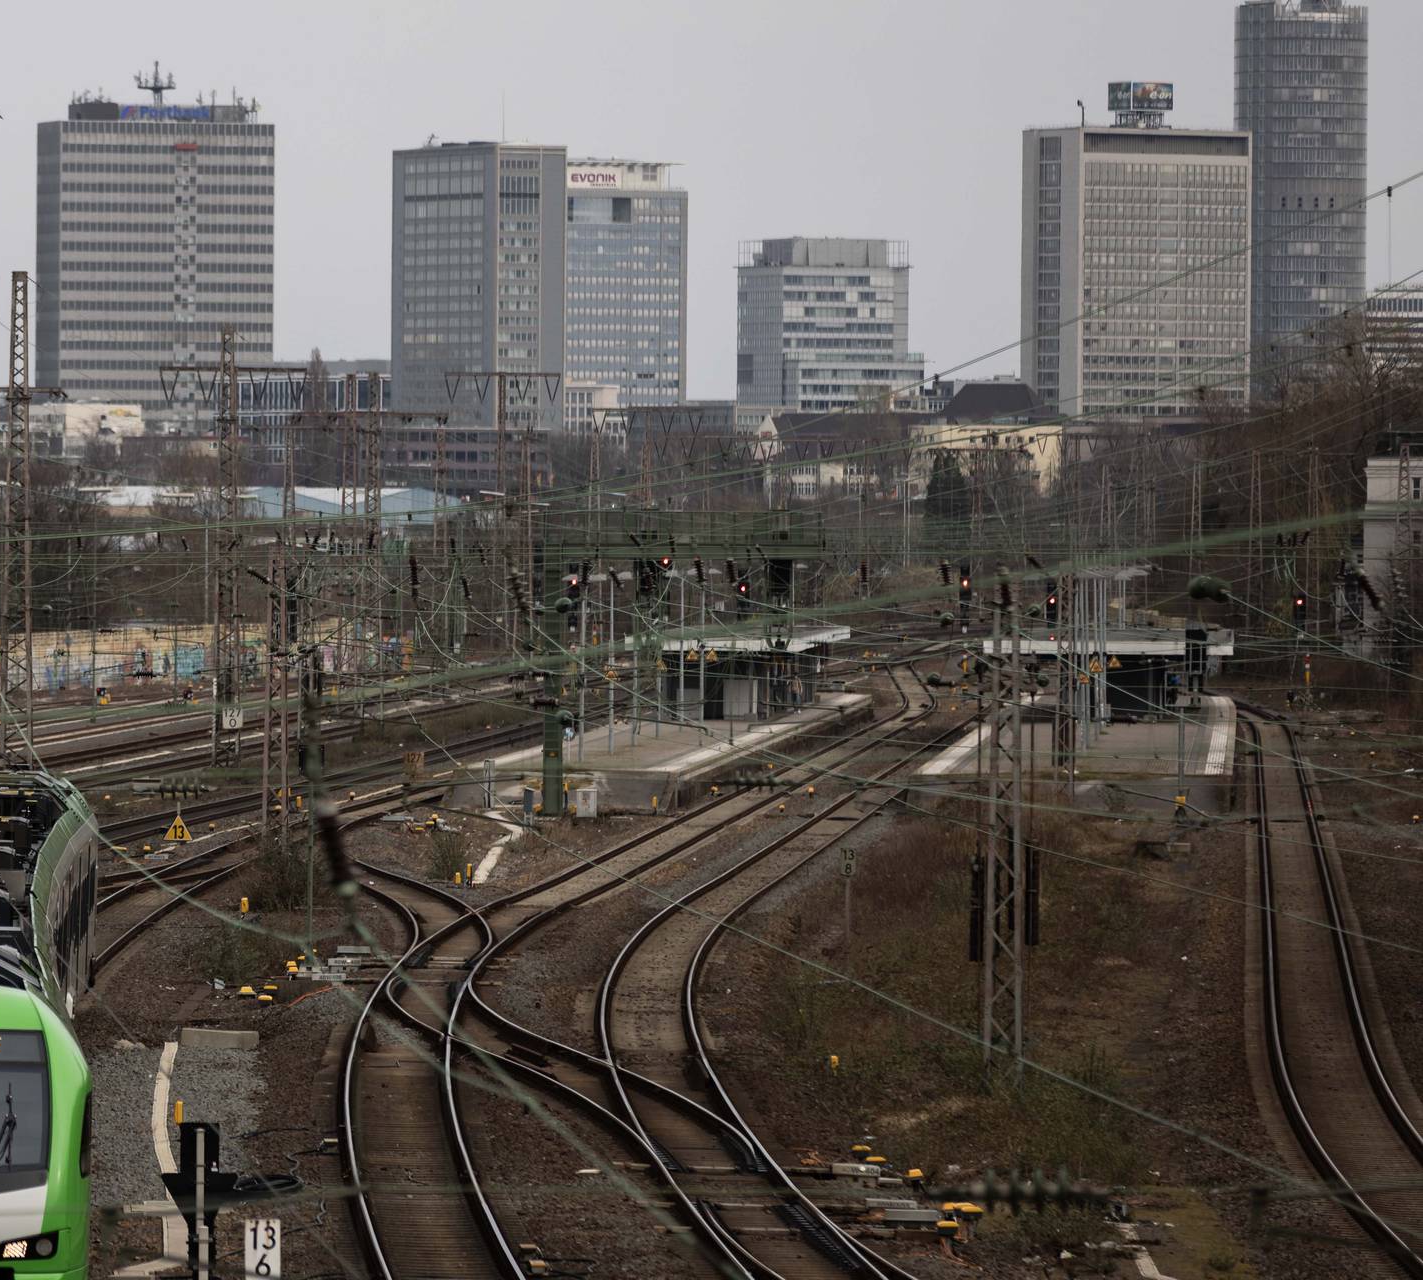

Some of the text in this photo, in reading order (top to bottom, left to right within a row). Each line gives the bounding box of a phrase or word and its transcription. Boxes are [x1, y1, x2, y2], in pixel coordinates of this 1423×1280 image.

[571, 173, 617, 183] EVONIK
[224, 707, 241, 718] 127
[172, 825, 185, 839] 13
[842, 849, 855, 861] 13
[844, 863, 852, 874] 8
[250, 1226, 276, 1250] 13
[255, 1253, 272, 1277] 6
